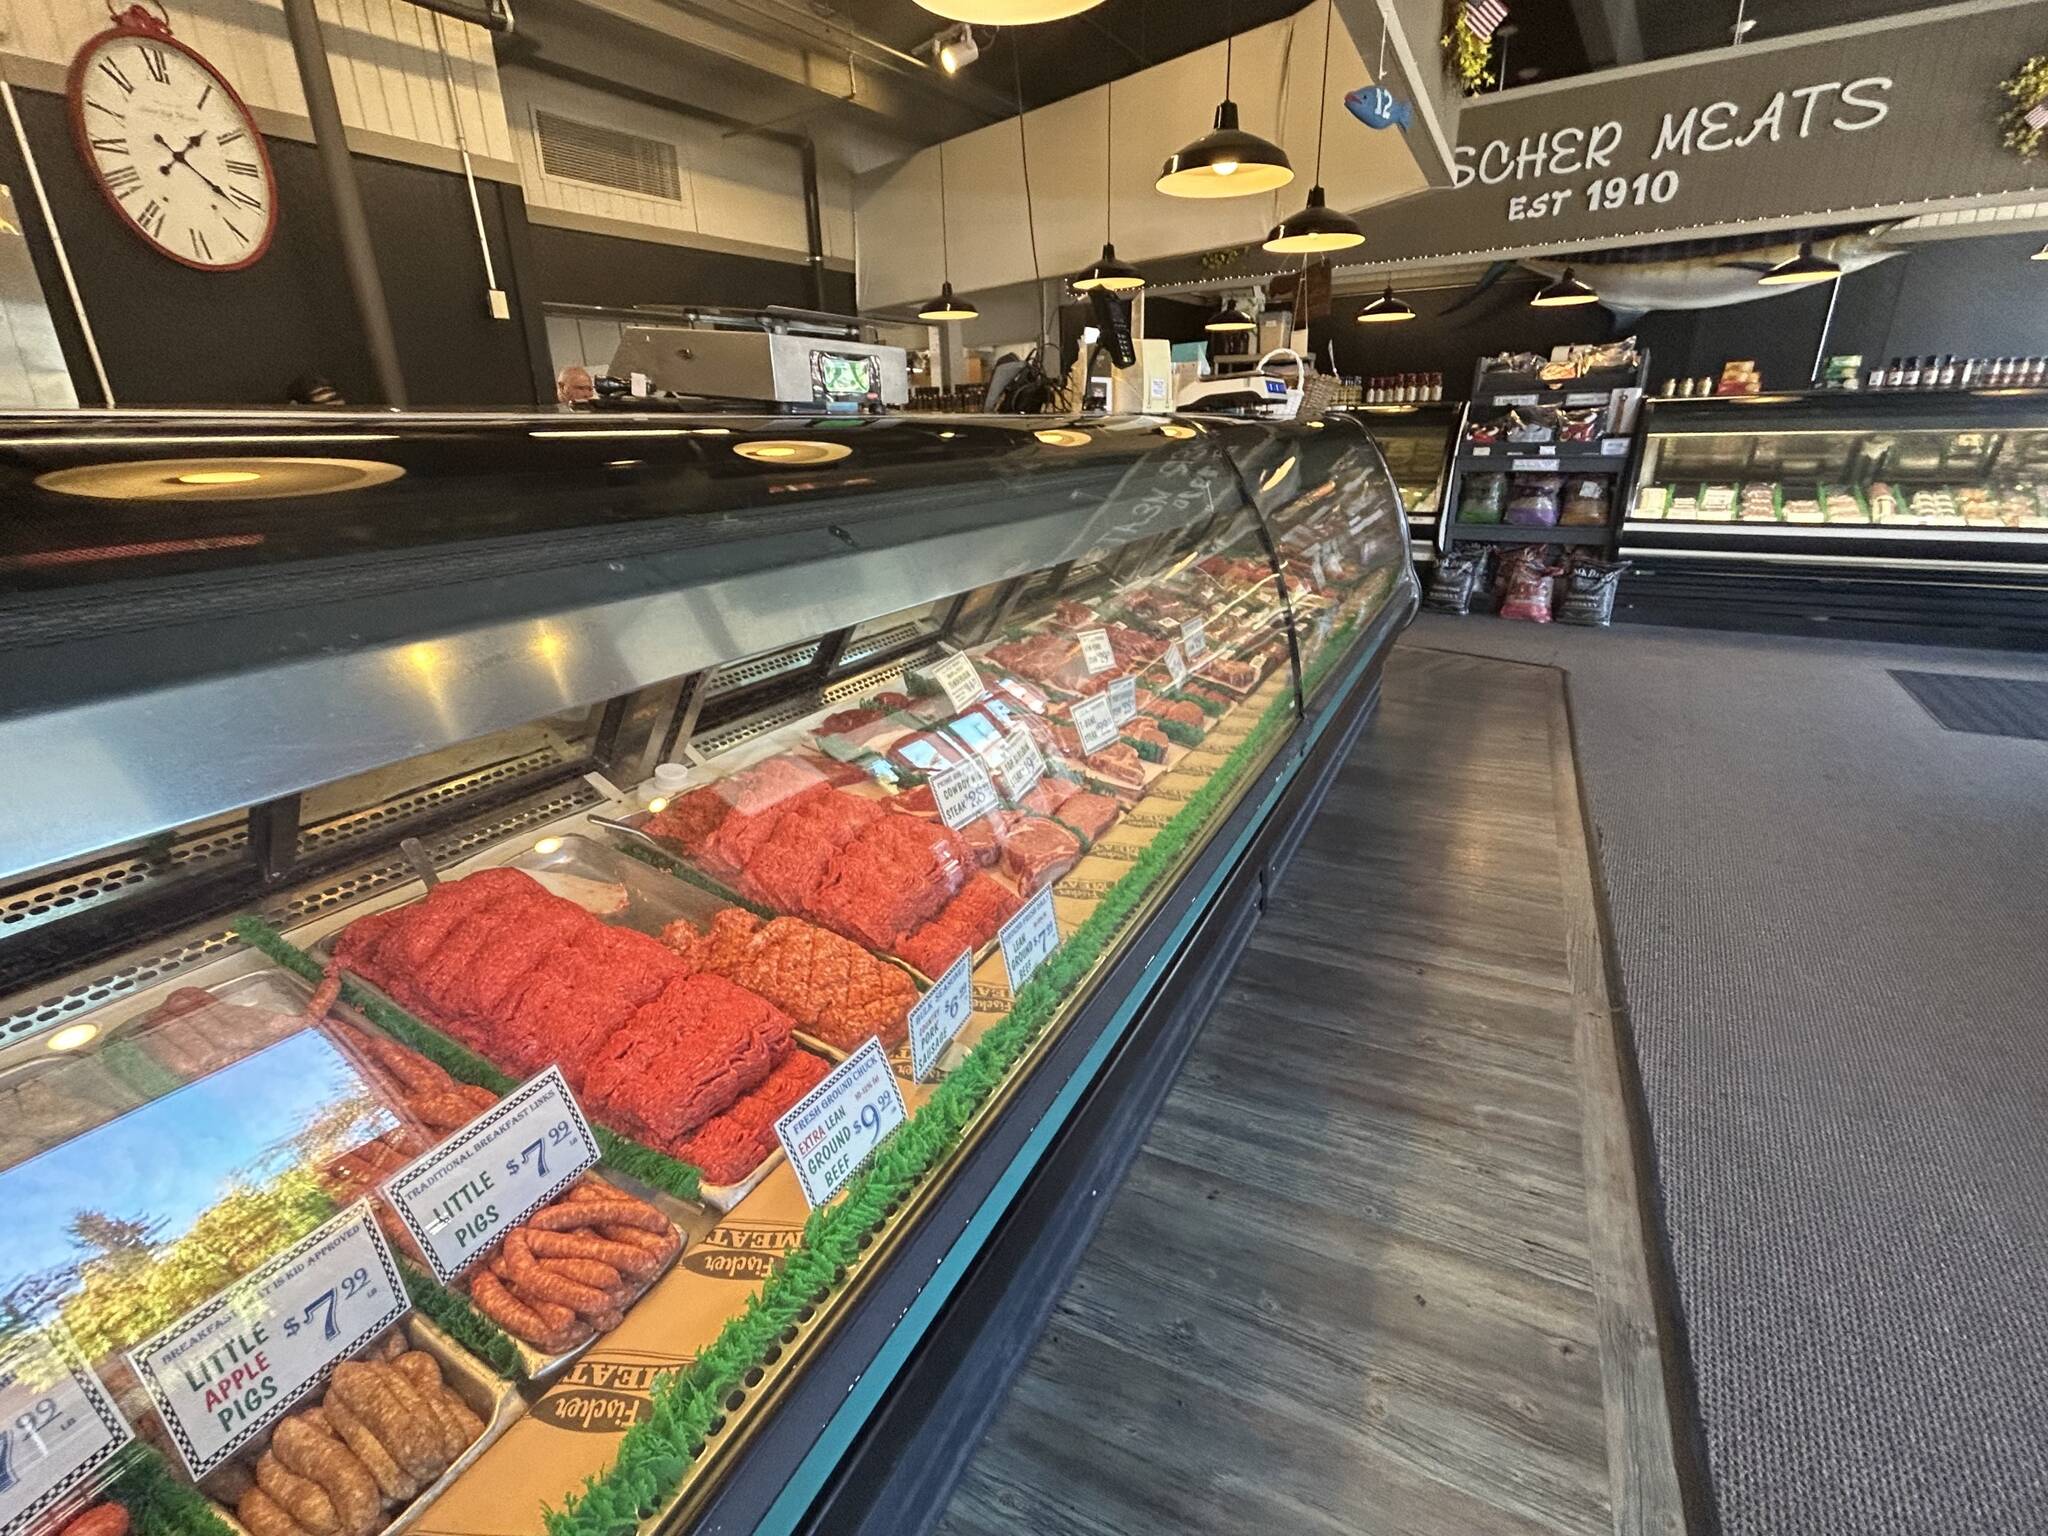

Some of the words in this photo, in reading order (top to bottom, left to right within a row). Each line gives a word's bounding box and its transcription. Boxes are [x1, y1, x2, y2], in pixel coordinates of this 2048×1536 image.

[1375, 88, 1392, 119] 12
[1651, 76, 1893, 159] MEATS
[1508, 189, 1571, 221] EST
[1587, 169, 1679, 212] 1910
[943, 777, 970, 800] COWBOY
[945, 801, 967, 820] STEAK
[1011, 940, 1033, 971] GROUND
[1013, 933, 1026, 953] LEAN
[1019, 959, 1032, 980] BEEF
[915, 1003, 933, 1025] BULK
[921, 1020, 940, 1050] PORK
[918, 1026, 948, 1072] SAUSAGE
[793, 1107, 822, 1134] FRESH
[821, 1078, 853, 1109] GROUND
[853, 1056, 879, 1081] CHUCK
[404, 1148, 474, 1202] TRADITIONAL
[473, 1108, 531, 1152] BREAKFAST
[529, 1089, 556, 1112] LINKS
[797, 1124, 827, 1156] EXTRA
[826, 1105, 847, 1131] LEAN
[807, 1125, 850, 1175] GROUND
[824, 1153, 850, 1188] BEEF
[433, 1170, 495, 1224] LITTLE
[454, 1204, 500, 1248] PIGS
[704, 1228, 805, 1249] MEAT
[285, 1262, 306, 1281] KID
[306, 1224, 361, 1265] APPROVED
[704, 1255, 775, 1278] Fischer
[185, 1320, 270, 1392] LITTLE
[204, 1351, 271, 1413] APPLE
[217, 1375, 278, 1433] PIGS
[554, 1397, 640, 1429] Fischer
